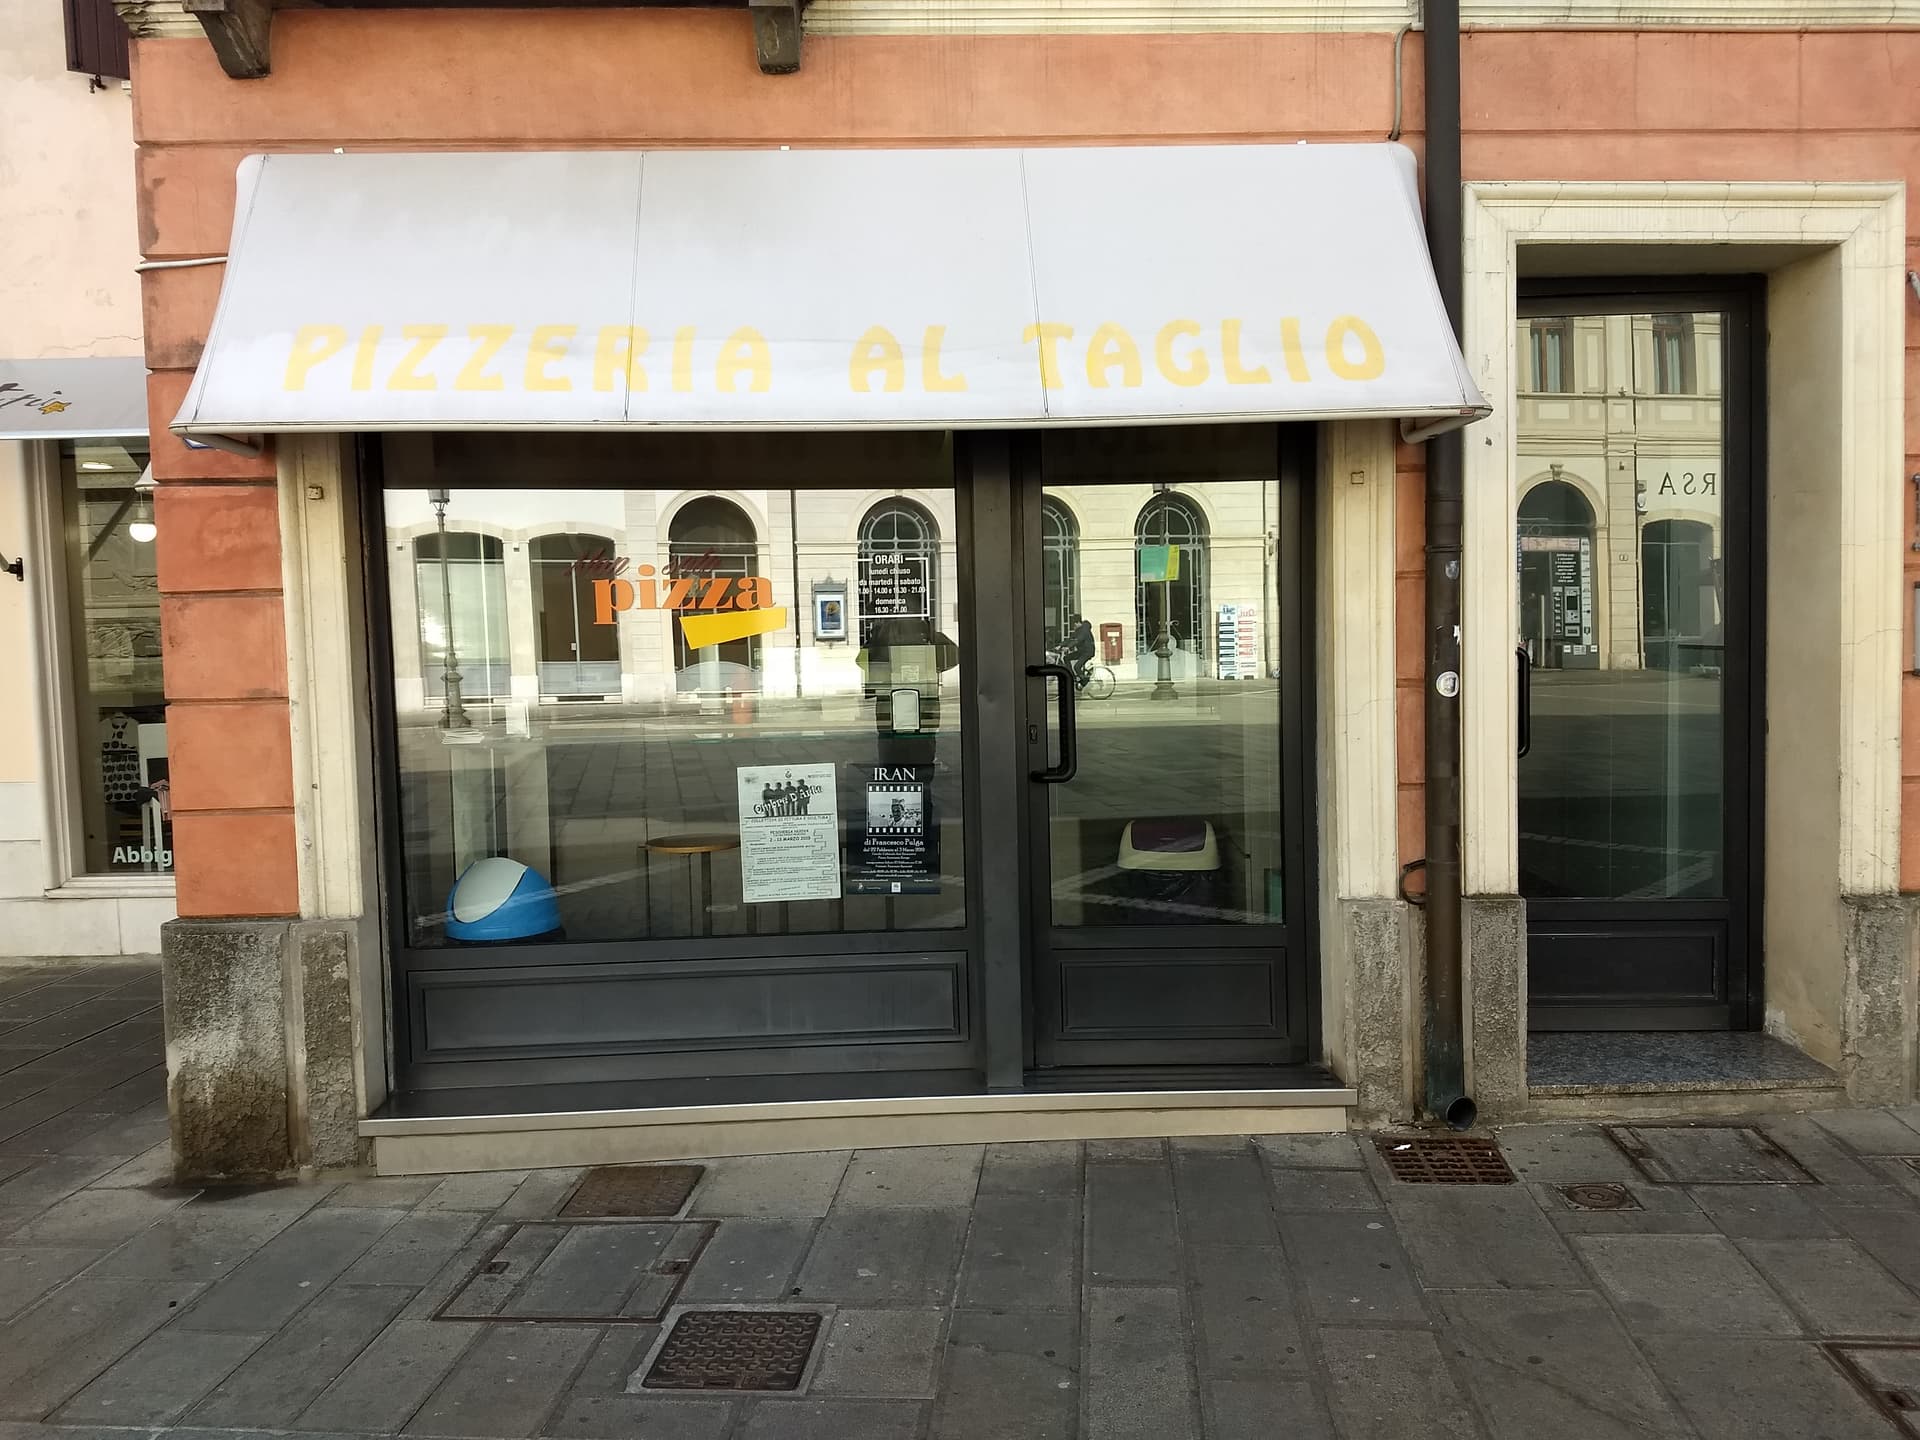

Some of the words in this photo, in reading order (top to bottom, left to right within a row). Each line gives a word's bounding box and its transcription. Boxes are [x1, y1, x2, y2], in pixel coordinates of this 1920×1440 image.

[283, 323, 773, 393] PIZZERIA
[848, 324, 968, 392] AL
[1023, 314, 1386, 390] TAGLIO
[874, 554, 904, 565] ORARI
[592, 564, 777, 625] pizza
[875, 597, 906, 605] domenica
[874, 768, 916, 781] IRAN
